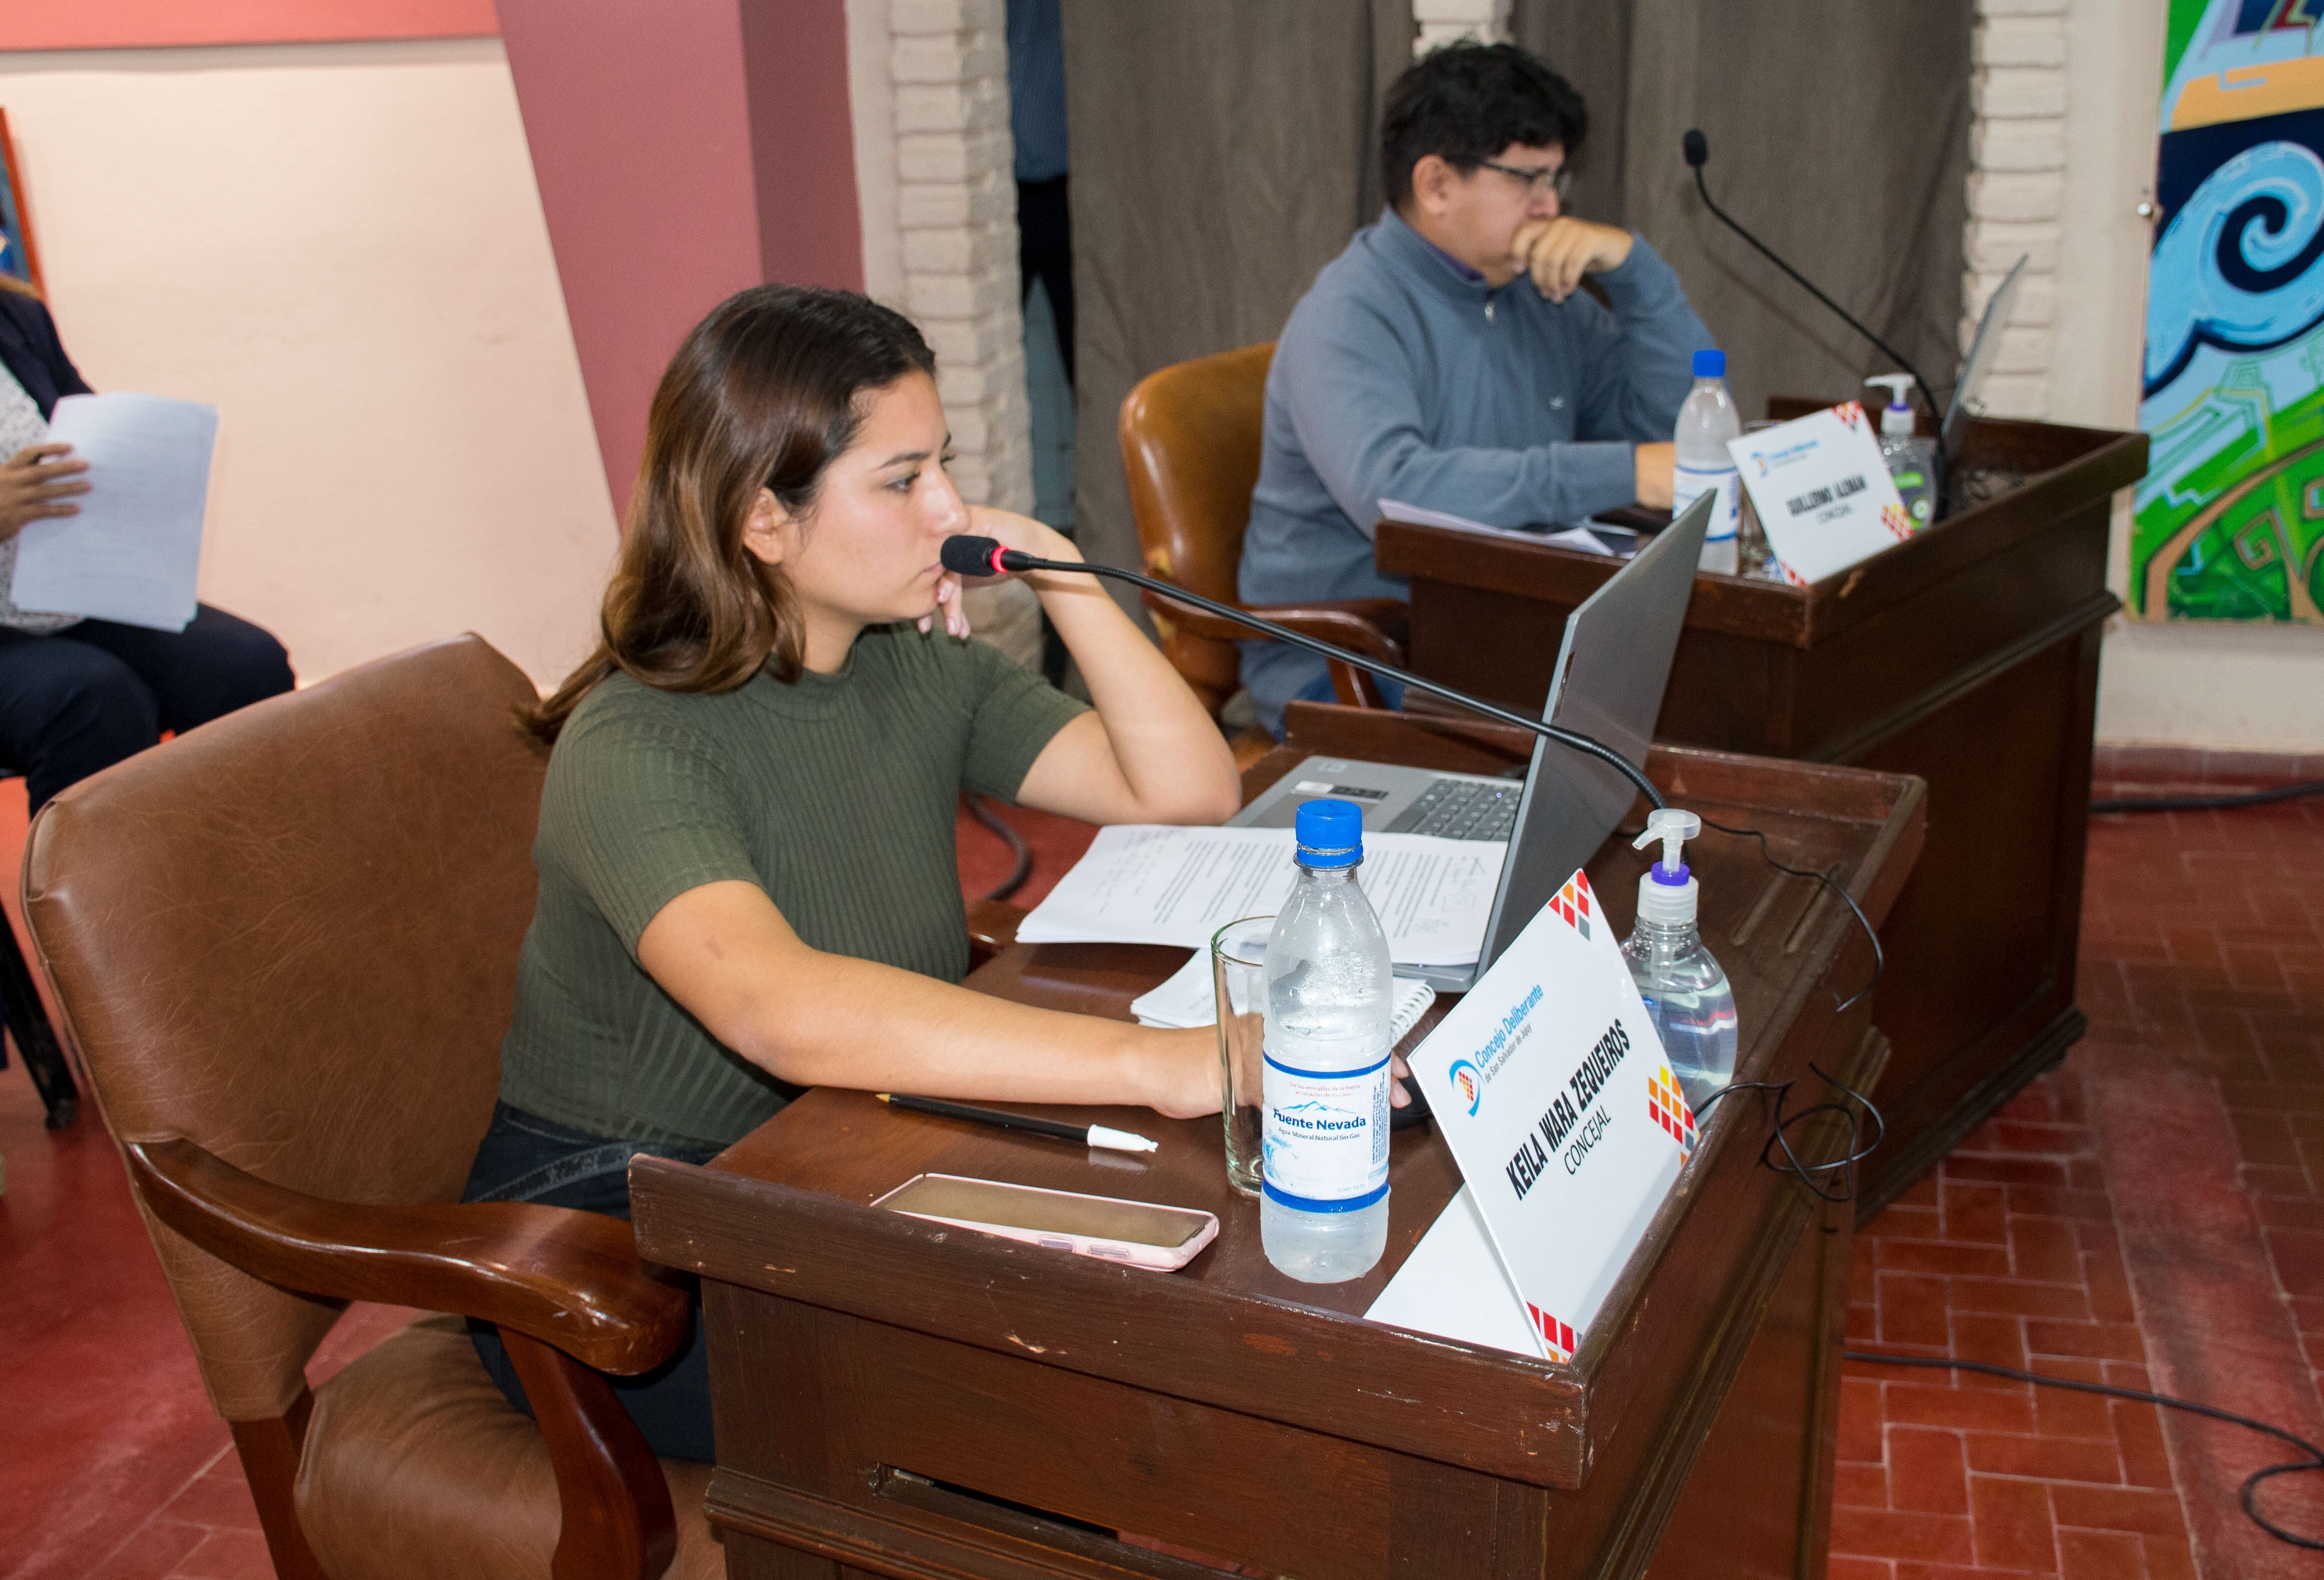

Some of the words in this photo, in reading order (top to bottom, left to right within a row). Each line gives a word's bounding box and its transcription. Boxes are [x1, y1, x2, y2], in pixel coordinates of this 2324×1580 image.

[1475, 1029, 1506, 1068] Concejo
[1502, 985, 1543, 1035] Deliberante
[1485, 1073, 1491, 1083] de
[1490, 1063, 1500, 1075] San
[1498, 1042, 1517, 1066] Salvador
[1516, 1036, 1522, 1046] de
[1521, 1023, 1533, 1040] Jujuy
[1273, 1107, 1313, 1129] Fuente
[1316, 1116, 1367, 1130] Nevada
[1278, 1127, 1291, 1135] Agua
[1292, 1131, 1314, 1140] Mineral
[1506, 1132, 1549, 1201] KEILA
[1539, 1090, 1578, 1152] WARA
[1569, 1018, 1630, 1112] ZEQUEIROS
[1564, 1104, 1611, 1175] CONCEJAL
